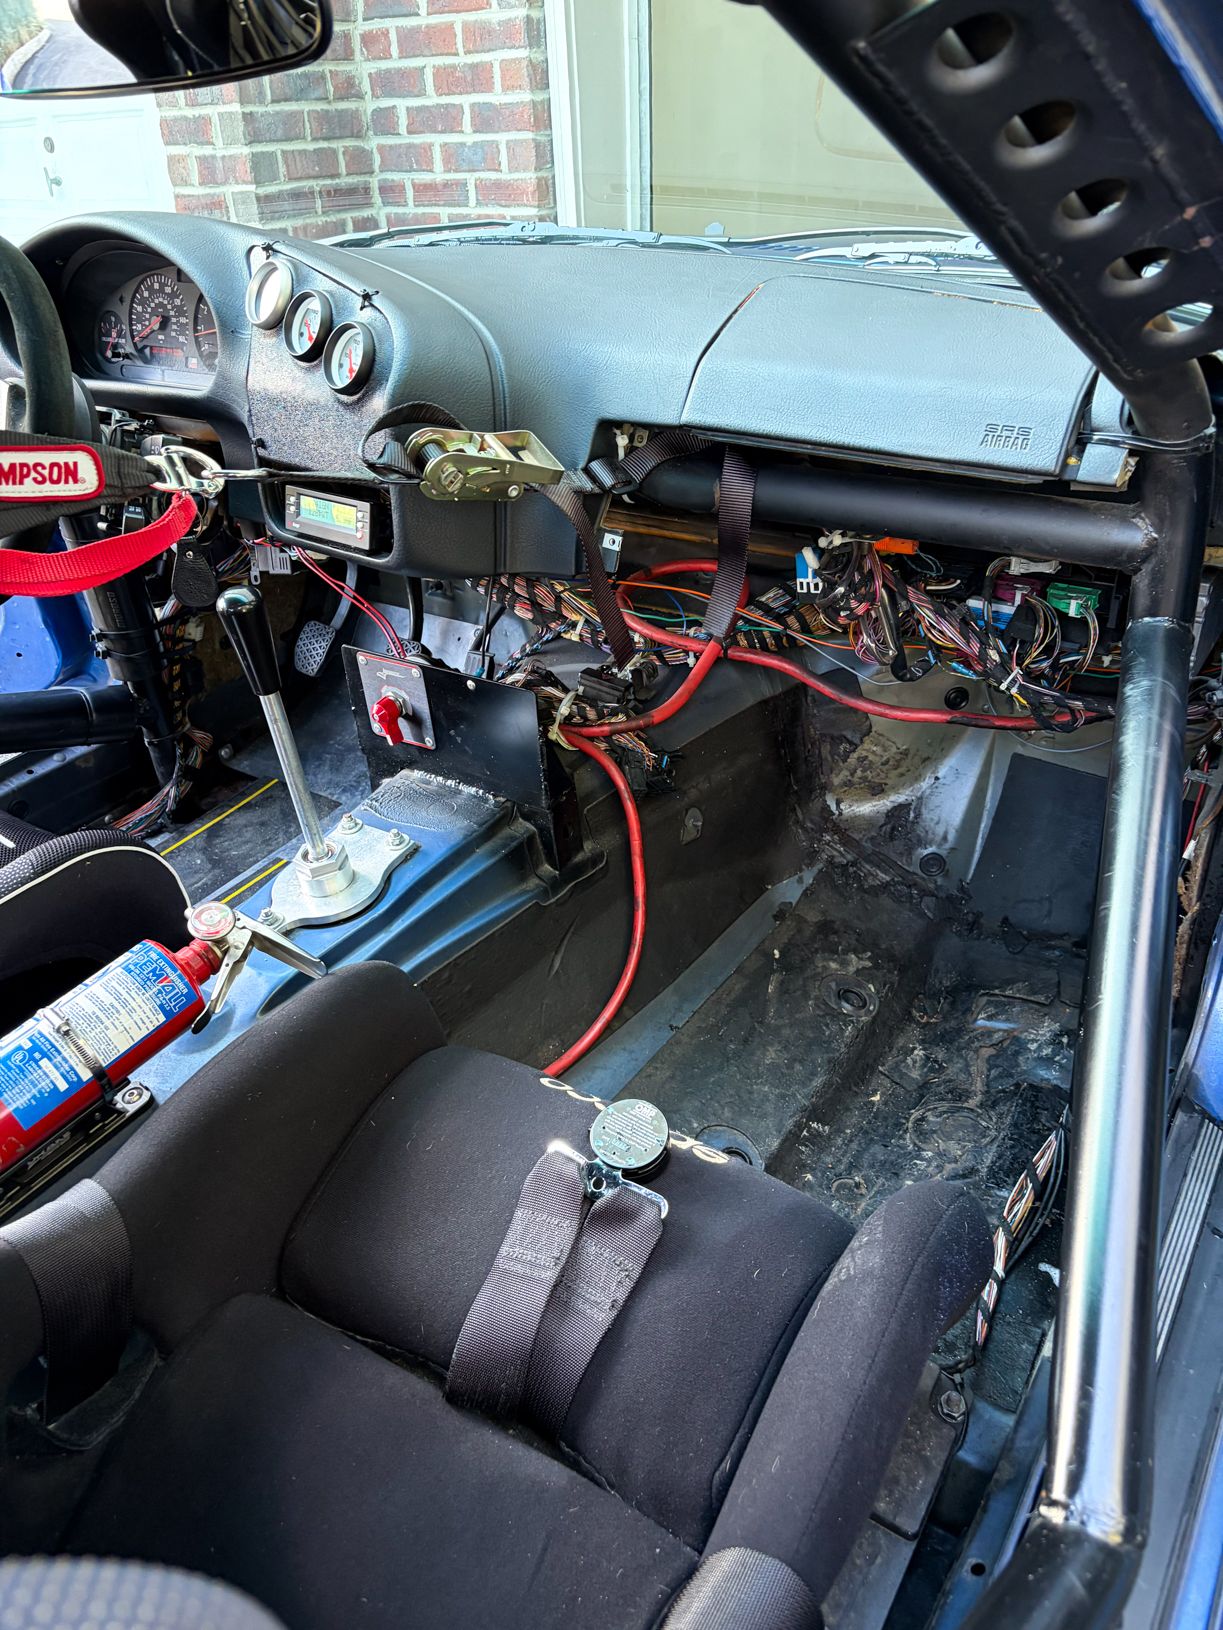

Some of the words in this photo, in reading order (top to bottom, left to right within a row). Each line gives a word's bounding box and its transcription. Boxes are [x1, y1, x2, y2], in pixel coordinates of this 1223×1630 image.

[985, 423, 1033, 437] SRS
[980, 433, 1031, 451] AIRBAG
[156, 958, 188, 994] EXTINGUISHER
[634, 1104, 656, 1118] OMP
